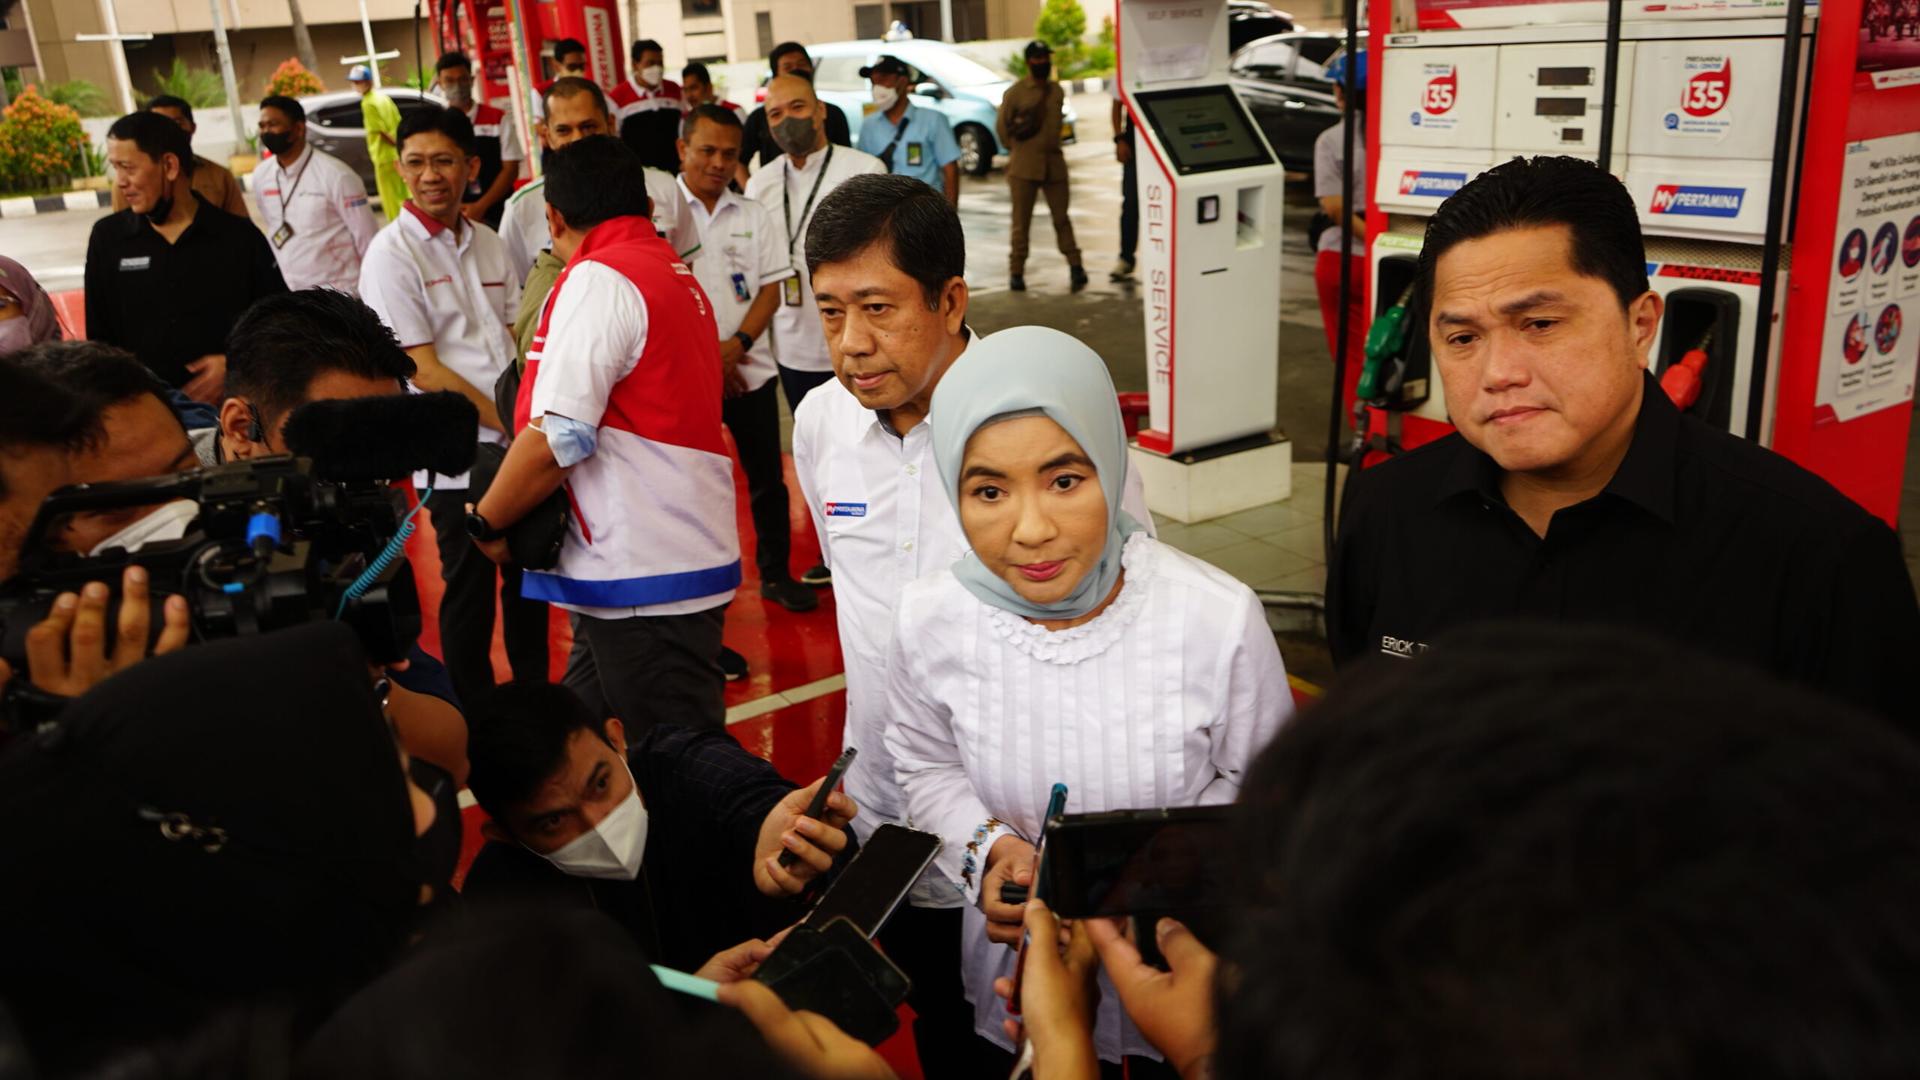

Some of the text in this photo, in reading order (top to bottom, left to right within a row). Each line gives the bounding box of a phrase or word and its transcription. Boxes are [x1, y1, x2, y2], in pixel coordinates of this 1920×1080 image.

[1424, 84, 1454, 109] 135
[1683, 81, 1724, 109] 135
[1147, 184, 1164, 253] SELF
[1151, 268, 1171, 385] SERVICE
[1382, 635, 1415, 654] ERICK
